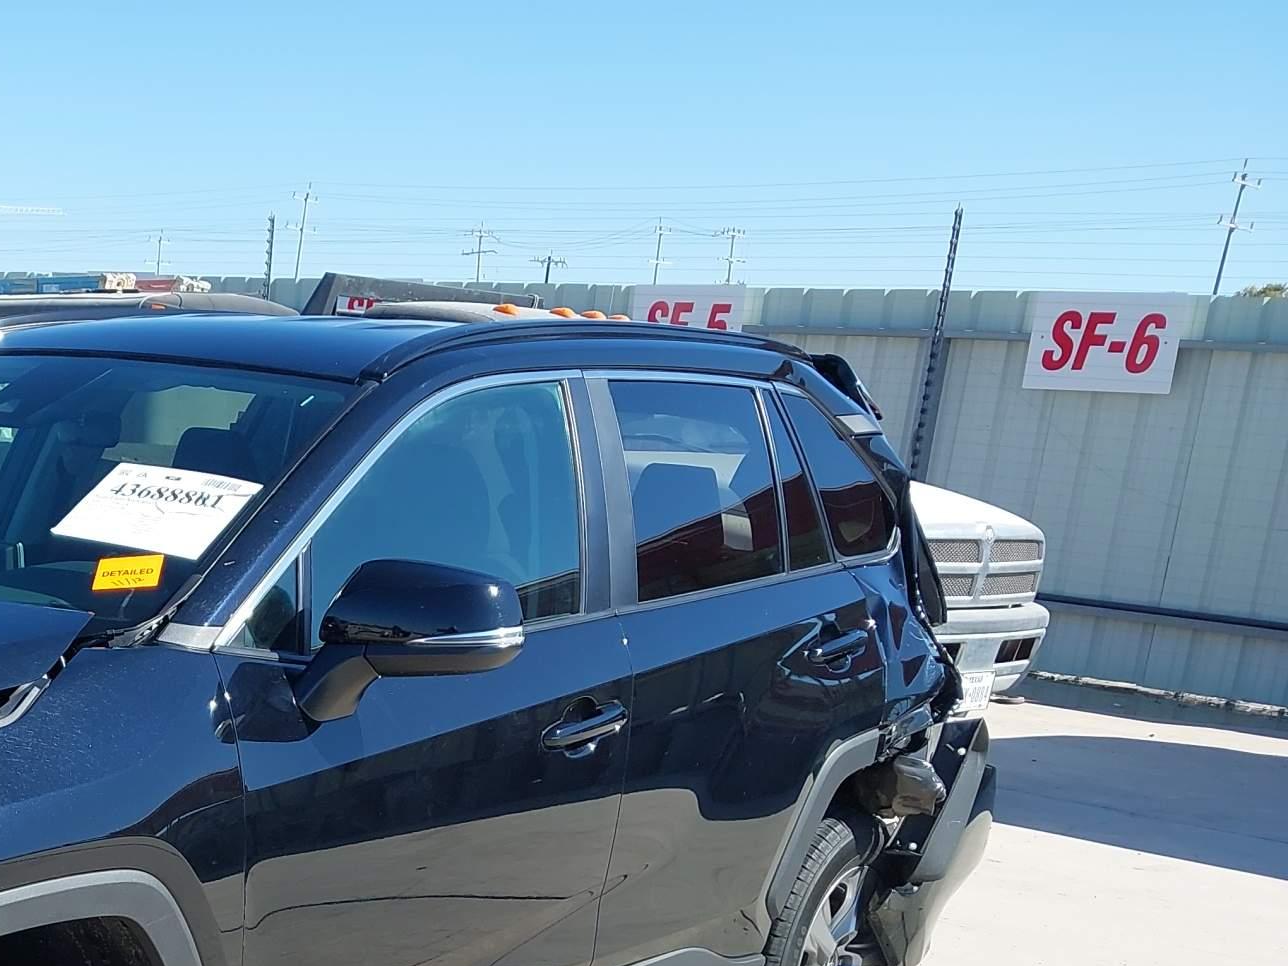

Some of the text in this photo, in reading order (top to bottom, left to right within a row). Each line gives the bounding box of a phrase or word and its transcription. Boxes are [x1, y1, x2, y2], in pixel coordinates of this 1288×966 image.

[648, 301, 733, 331] SF5
[1041, 310, 1168, 374] SF-6
[102, 567, 154, 577] DETAILED
